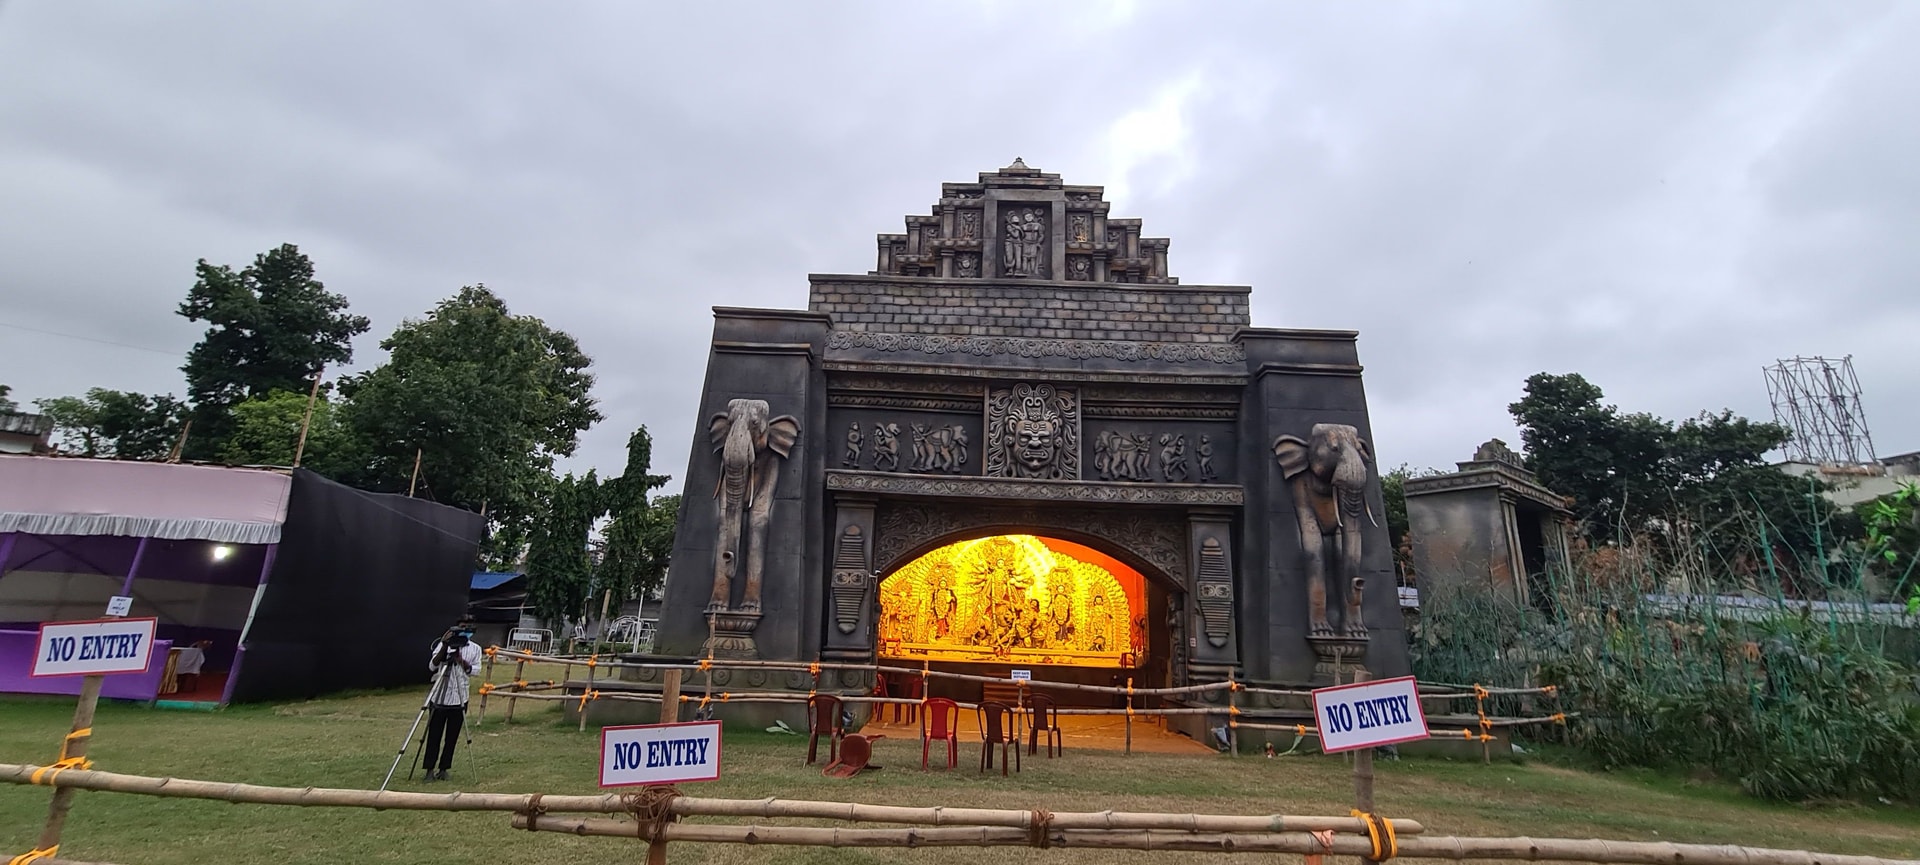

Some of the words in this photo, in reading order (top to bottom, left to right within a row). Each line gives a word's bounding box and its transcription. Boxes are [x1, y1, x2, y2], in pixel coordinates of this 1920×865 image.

[46, 636, 75, 662] NO
[78, 633, 143, 660] ENTRY
[1325, 703, 1353, 734] NO
[1354, 694, 1412, 729] ENTRY
[613, 741, 641, 770] NO
[646, 737, 710, 768] ENTRY
